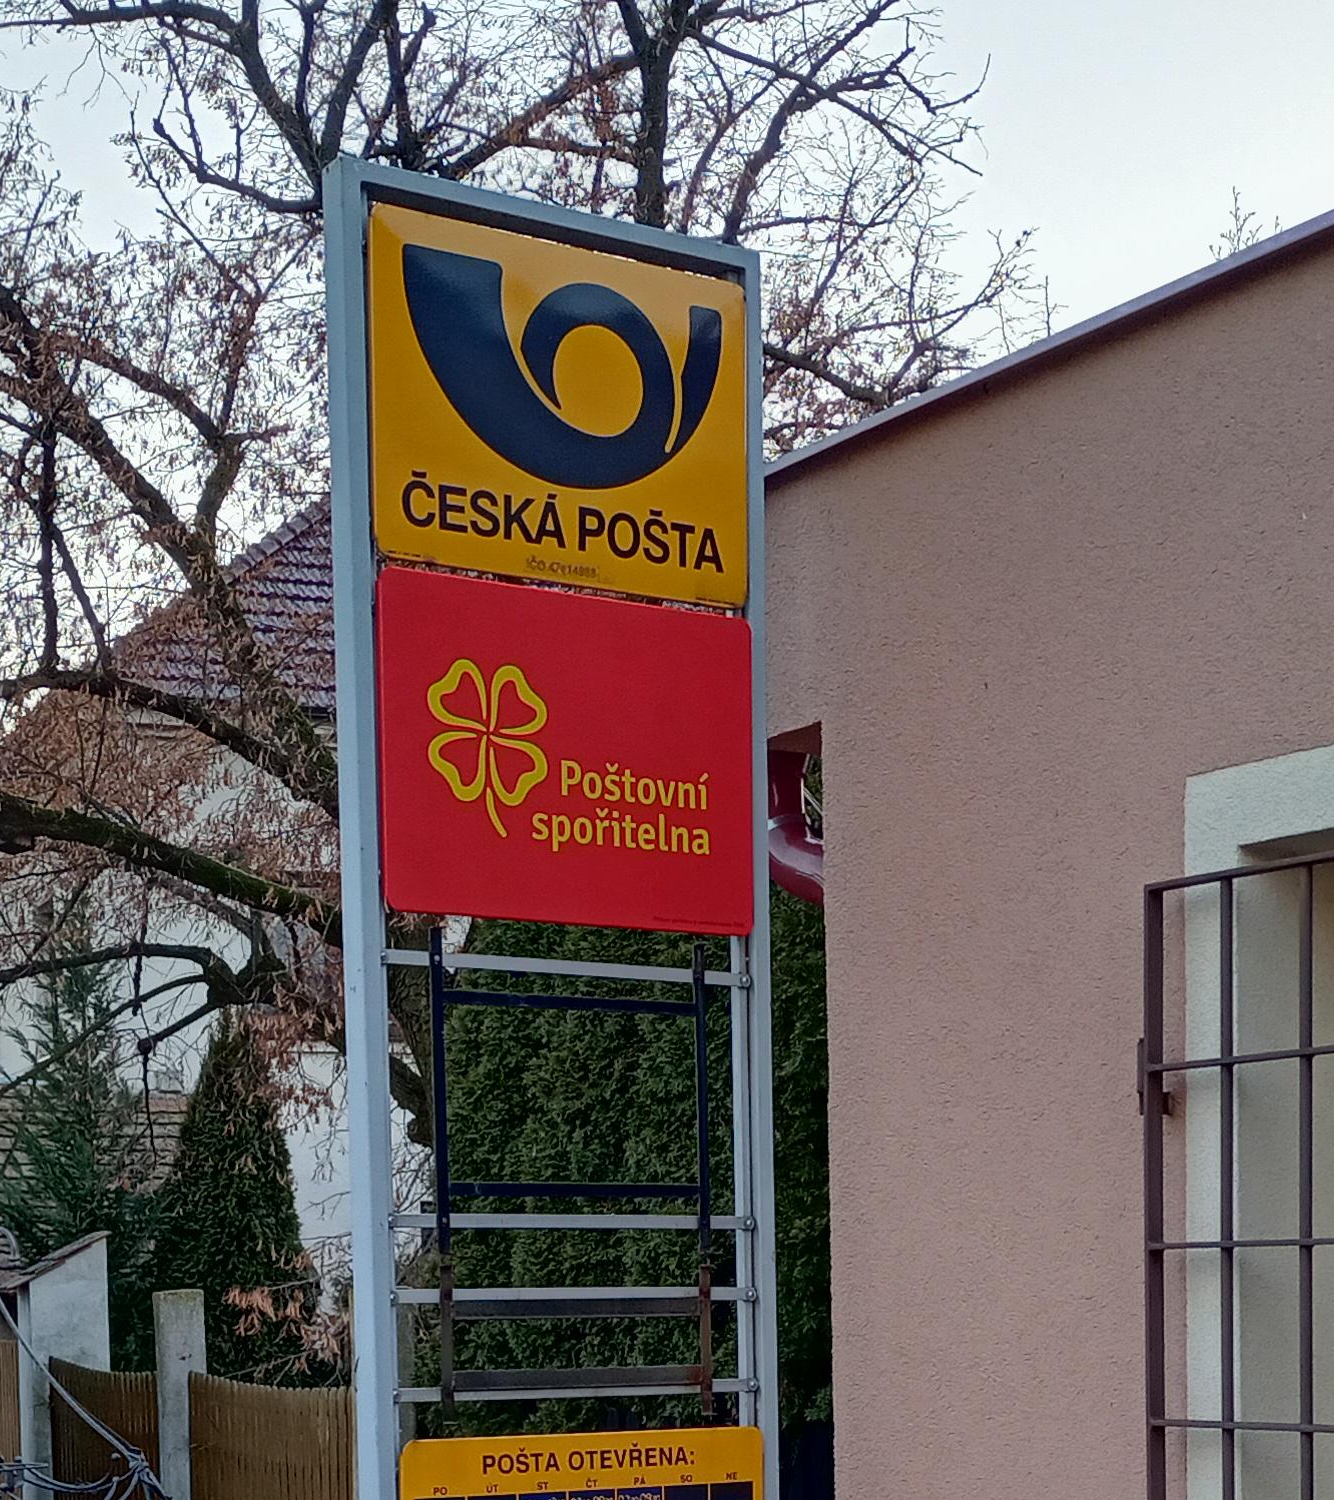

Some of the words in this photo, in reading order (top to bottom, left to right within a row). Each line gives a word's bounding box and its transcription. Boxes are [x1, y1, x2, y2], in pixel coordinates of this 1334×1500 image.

[401, 470, 567, 549] ČESKÁ
[577, 506, 725, 573] POŠTA
[560, 759, 709, 810] Poštovní
[531, 807, 710, 855] spořitelna
[482, 1447, 560, 1475] POŠTA
[568, 1442, 695, 1471] OTEVŘENA:
[433, 1487, 447, 1496] PO
[536, 1481, 549, 1491] ST
[585, 1477, 598, 1488] ČT
[725, 1471, 738, 1481] NE
